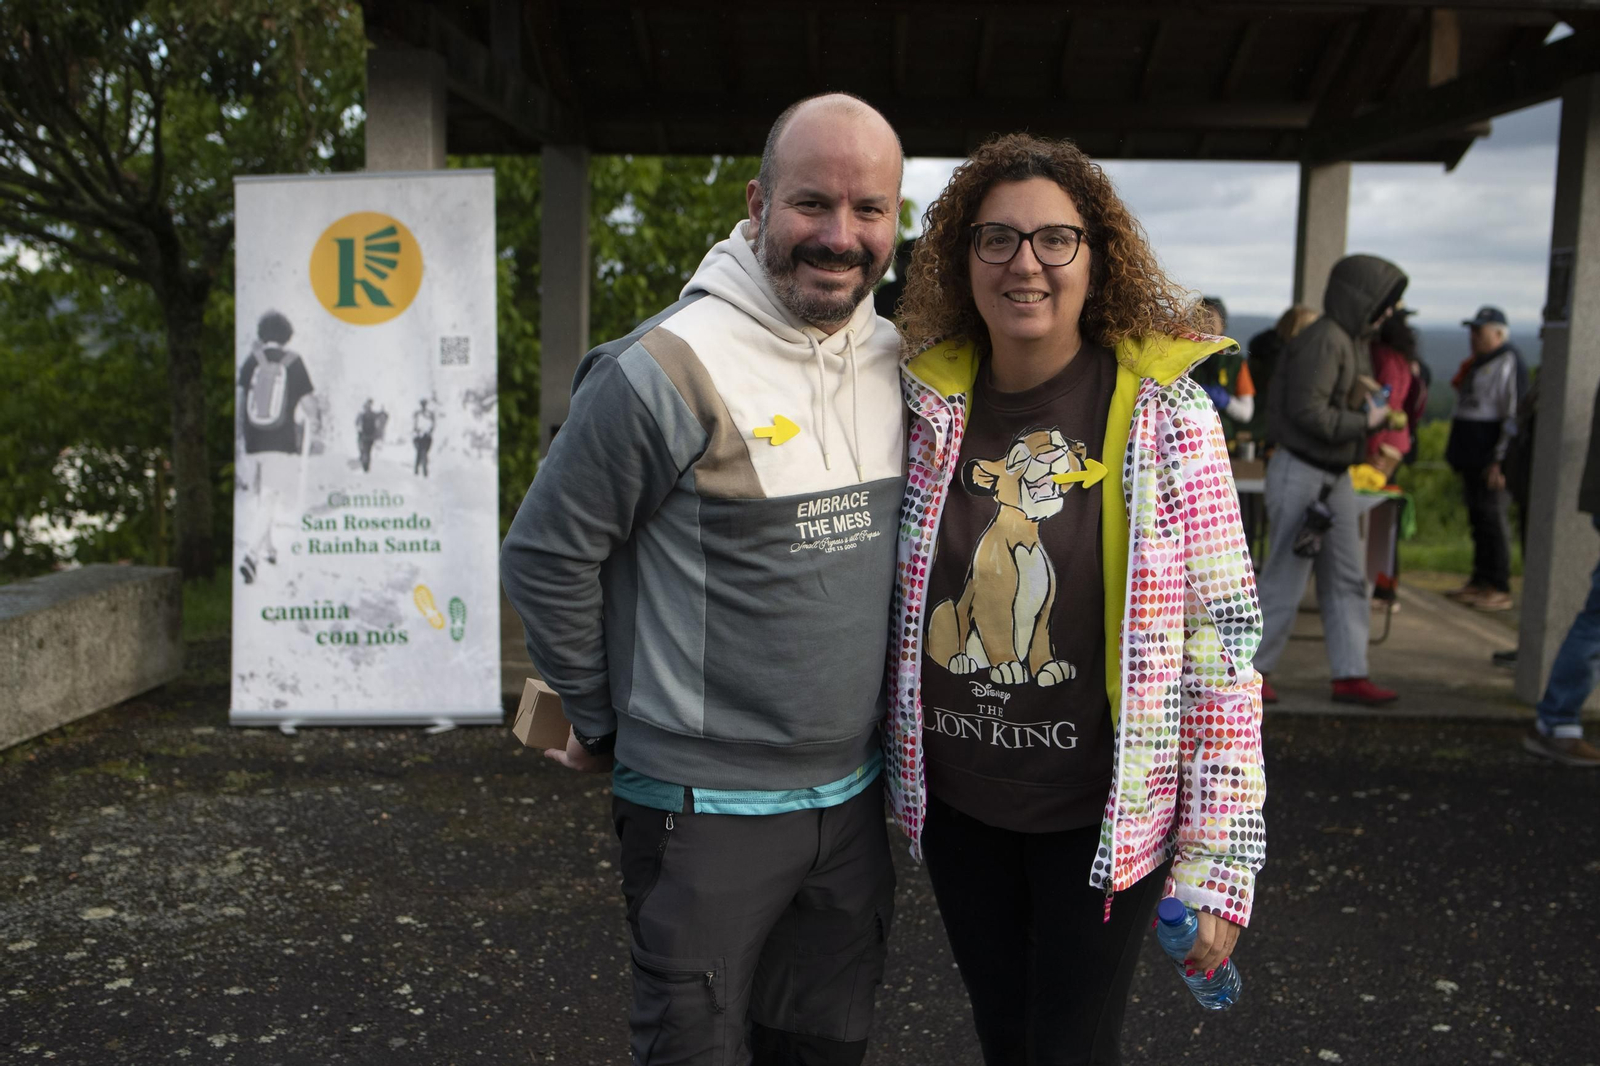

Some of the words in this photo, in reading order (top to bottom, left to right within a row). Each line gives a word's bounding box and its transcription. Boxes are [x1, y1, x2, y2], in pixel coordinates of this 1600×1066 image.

[327, 490, 404, 508] Camiño
[797, 491, 869, 518] EMBRACE
[302, 514, 337, 531] San
[344, 513, 431, 530] Rosendo
[795, 518, 831, 539] THE
[832, 510, 872, 534] MESS
[308, 537, 379, 554] Rainha
[385, 536, 441, 553] Santa
[261, 600, 350, 622] camiña
[316, 630, 358, 646] con
[366, 624, 409, 646] nós
[977, 704, 1004, 717] THE
[922, 705, 983, 741] LION
[990, 721, 1079, 749] KING
